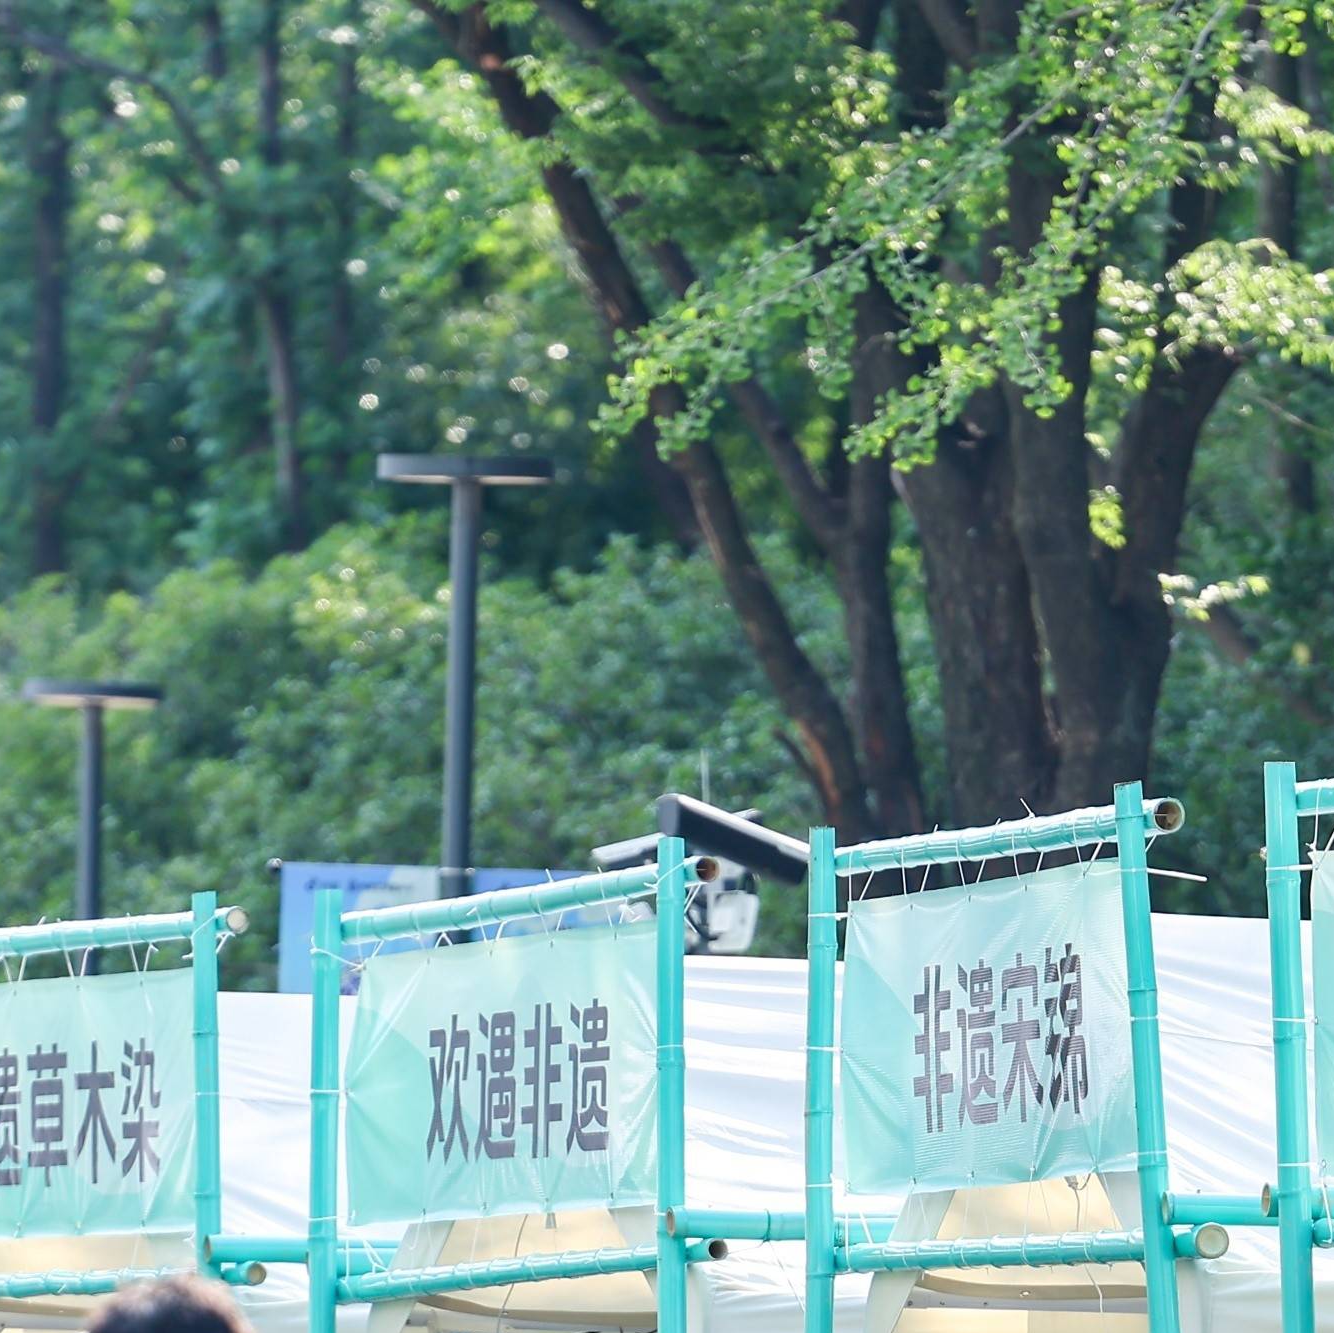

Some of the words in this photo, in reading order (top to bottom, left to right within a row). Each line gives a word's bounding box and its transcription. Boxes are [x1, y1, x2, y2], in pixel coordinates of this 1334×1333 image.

[426, 998, 610, 1166] 欢遇非遗
[913, 943, 1088, 1133] 非遗宋锦
